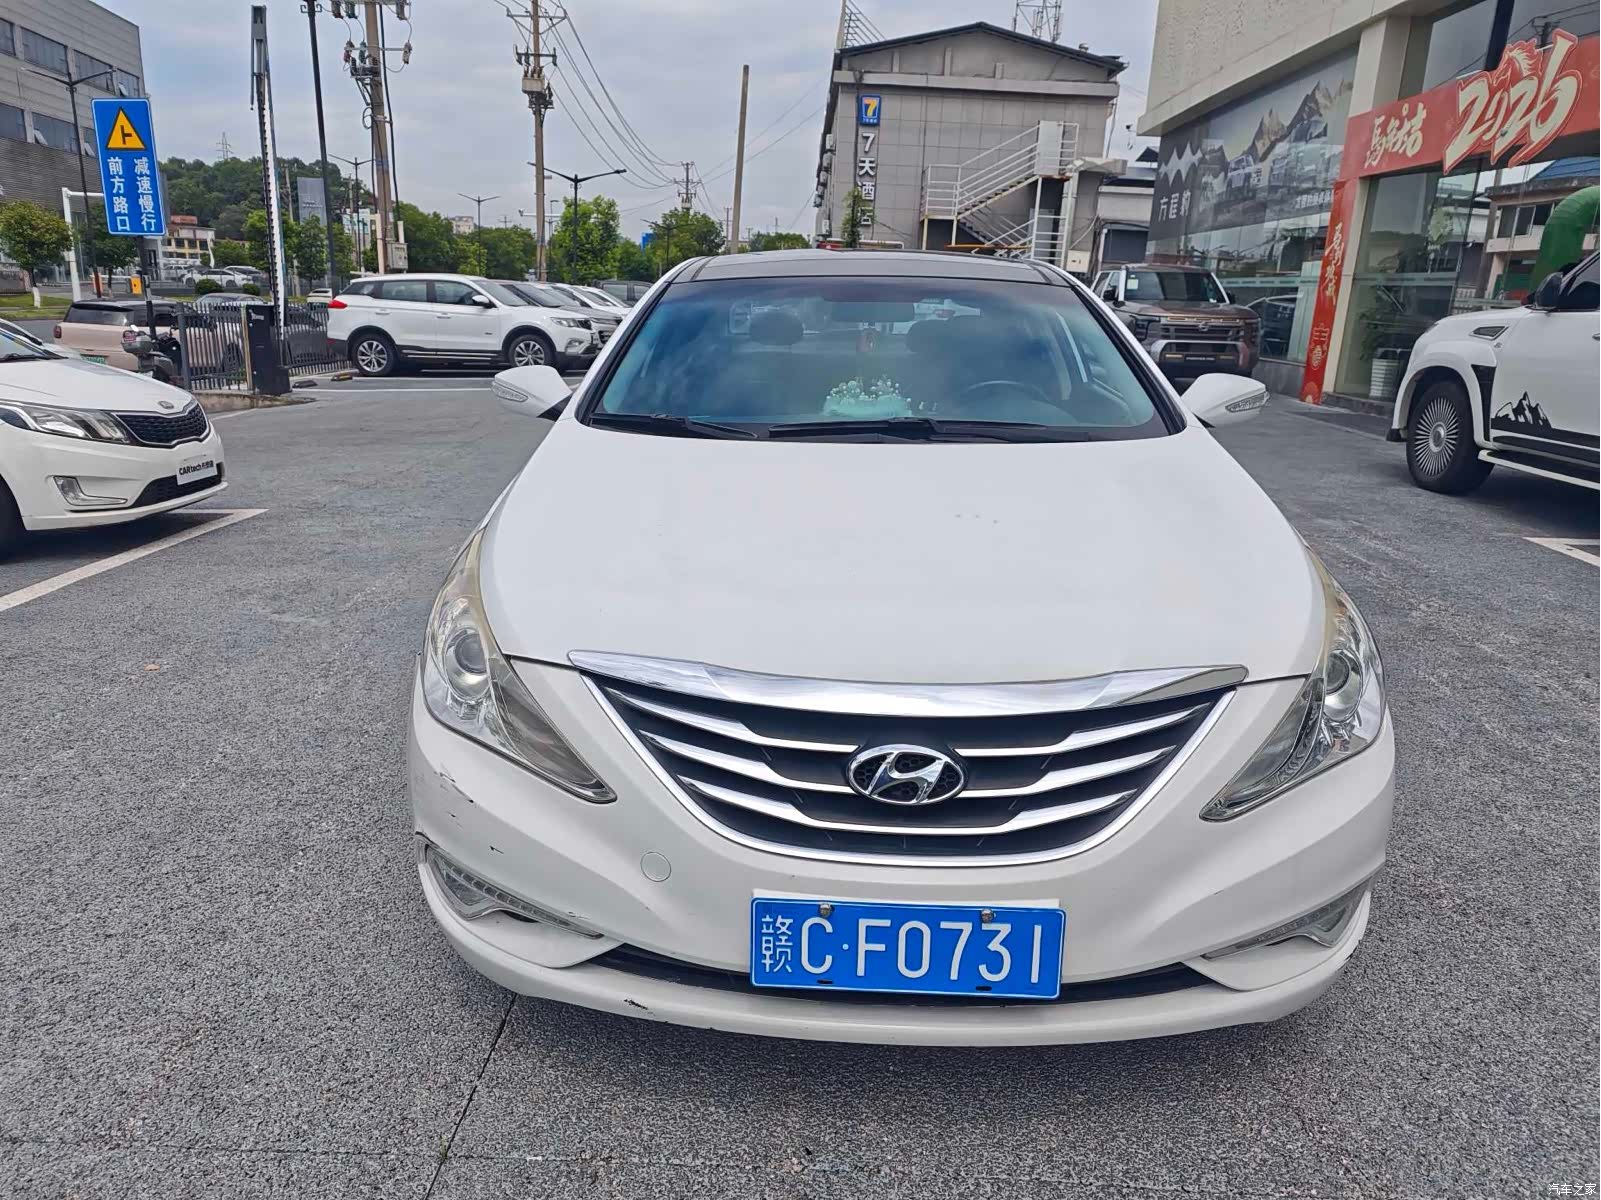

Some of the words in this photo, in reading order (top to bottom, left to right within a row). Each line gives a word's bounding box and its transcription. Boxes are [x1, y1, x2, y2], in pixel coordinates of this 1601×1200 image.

[1443, 30, 1582, 173] 2026
[107, 156, 131, 231] 前方路口
[133, 156, 156, 231] 减速慢行
